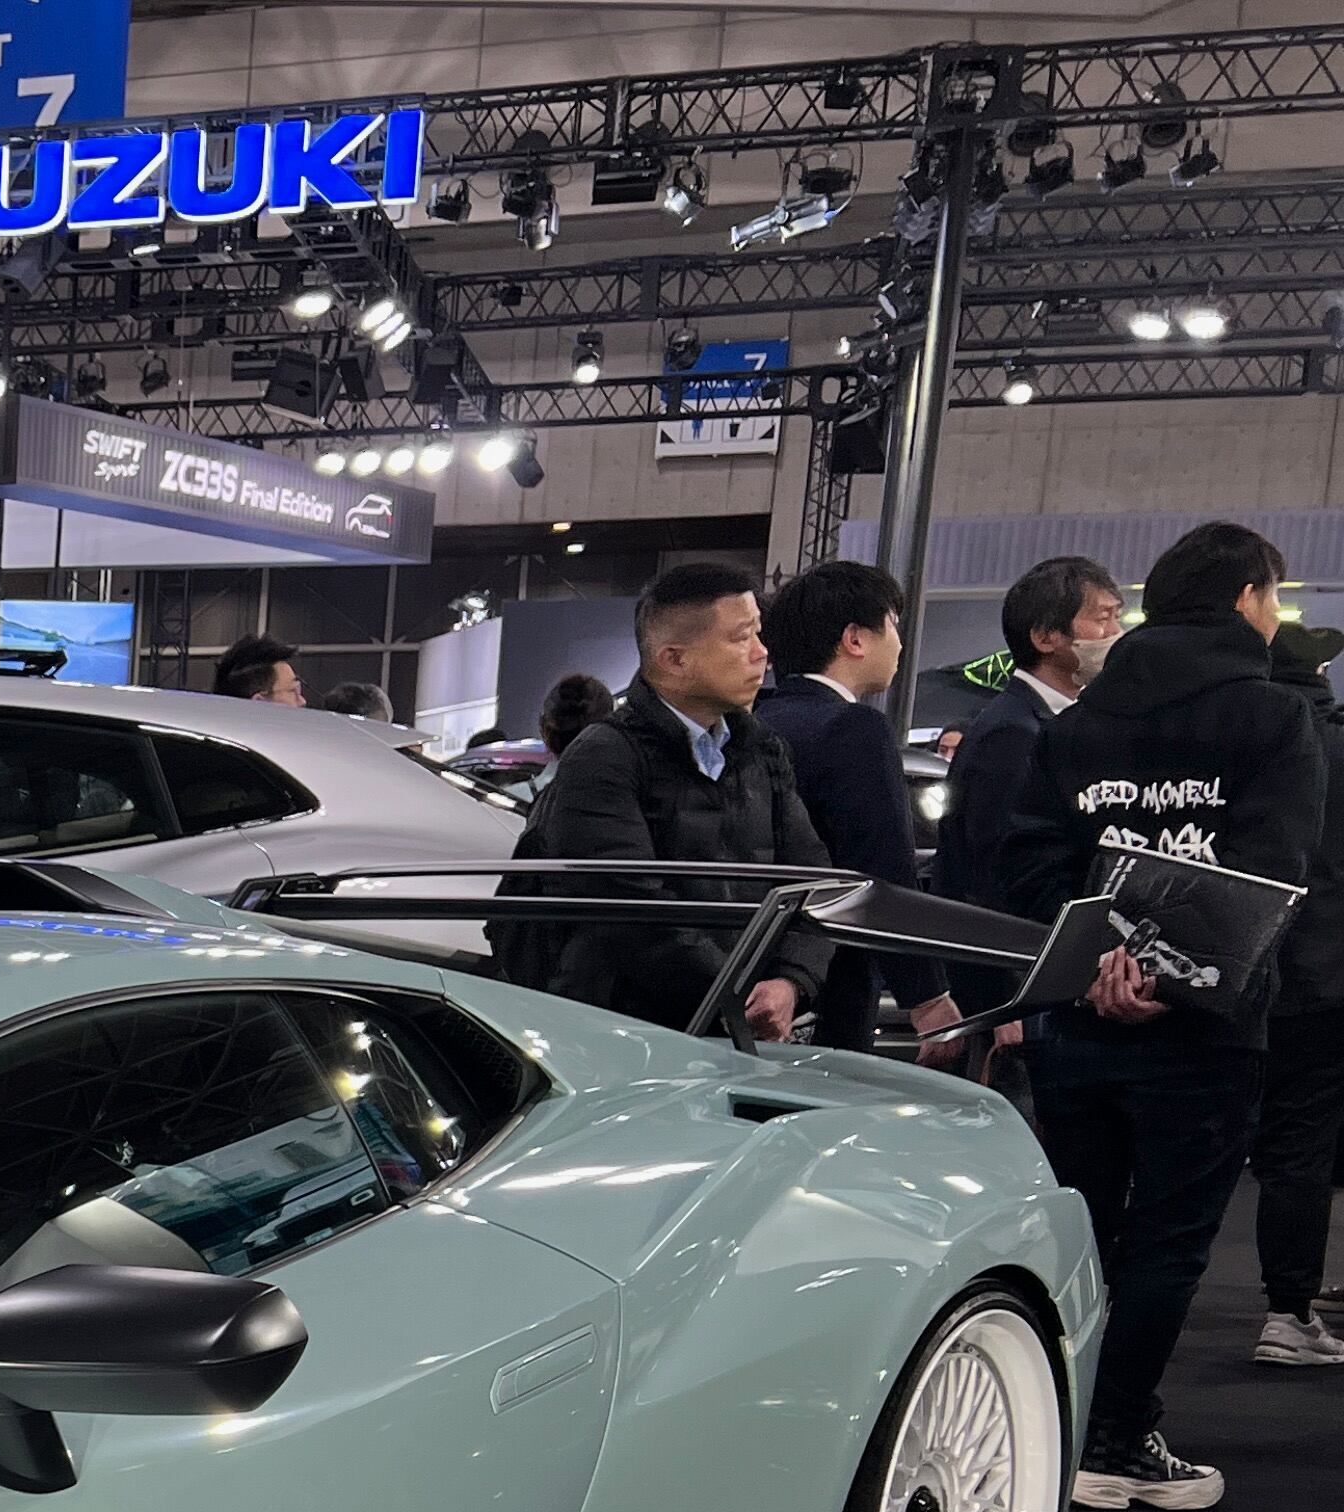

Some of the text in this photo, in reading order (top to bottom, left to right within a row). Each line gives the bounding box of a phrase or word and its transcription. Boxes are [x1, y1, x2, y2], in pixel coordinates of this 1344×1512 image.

[17, 74, 75, 128] 7
[83, 429, 147, 464] SWIFT
[93, 460, 141, 483] Sport
[160, 450, 334, 524] ZC33S Final Edition
[1078, 777, 1226, 815] NEED MONEY
